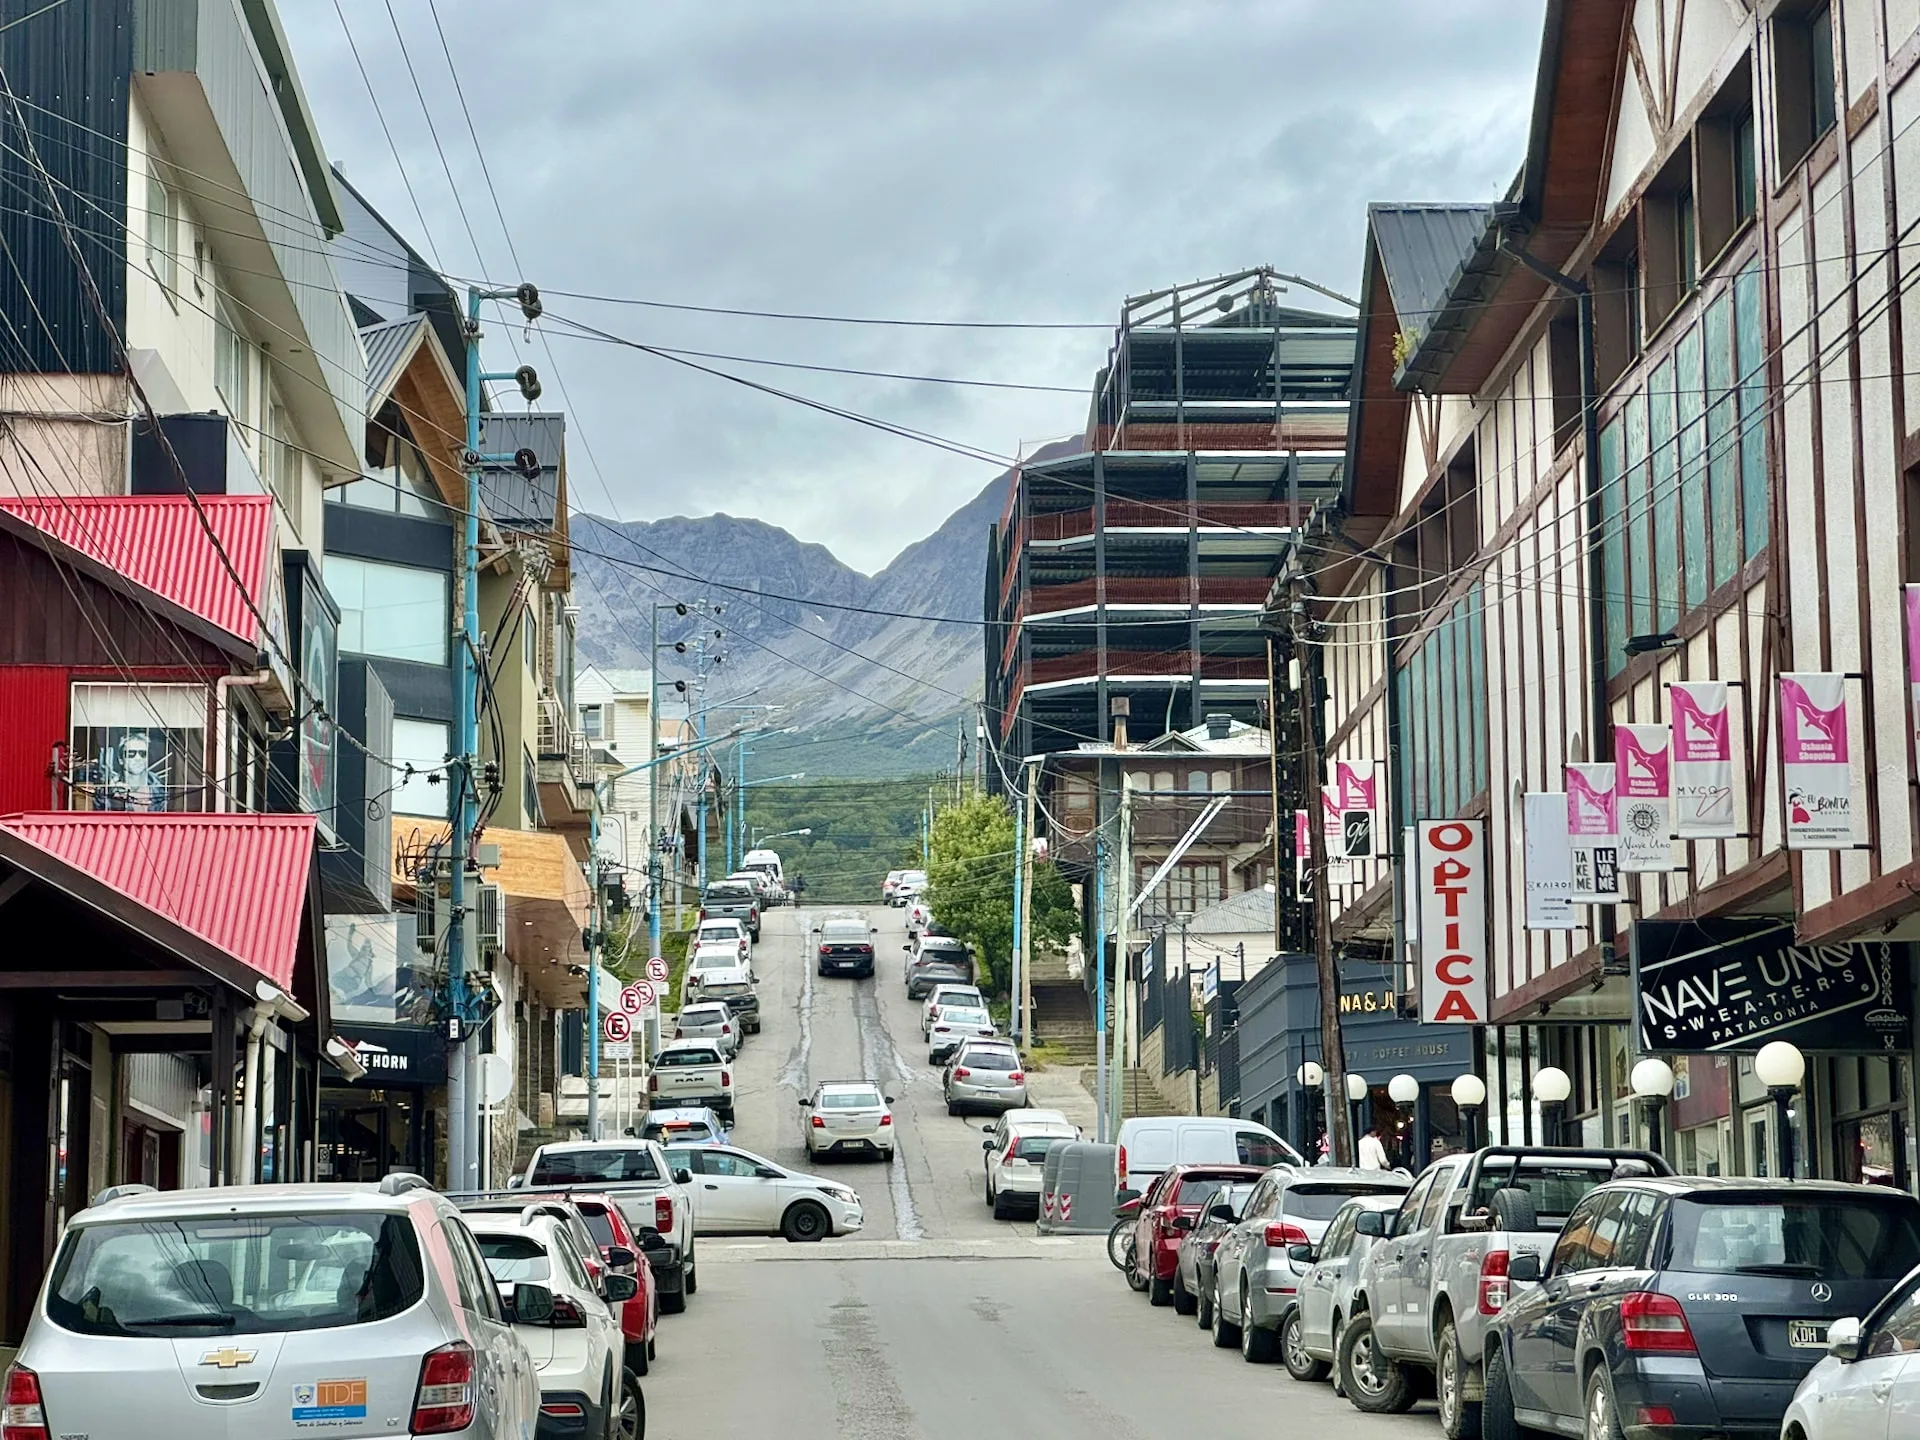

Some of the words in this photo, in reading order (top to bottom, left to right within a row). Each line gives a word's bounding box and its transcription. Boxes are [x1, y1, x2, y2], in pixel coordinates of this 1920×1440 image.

[1574, 851, 1588, 863] TA
[1596, 850, 1615, 864] LLE
[1576, 865, 1588, 876] KE
[1598, 864, 1613, 877] VA
[1576, 878, 1592, 891] ME
[1599, 877, 1615, 891] ME
[1428, 823, 1478, 1020] OPTICA
[1641, 961, 1752, 1025] NAVE
[1364, 992, 1377, 1012] &
[612, 1019, 624, 1034] E
[1712, 1001, 1818, 1041] PATAGONIA
[1373, 1046, 1410, 1059] COFFEE
[1415, 1043, 1449, 1055] HOUSE
[372, 1054, 408, 1070] HORN
[1688, 1293, 1711, 1301] GLK
[1715, 1293, 1738, 1302] 300
[1792, 1326, 1817, 1343] KDH
[319, 1383, 364, 1405] TDF
